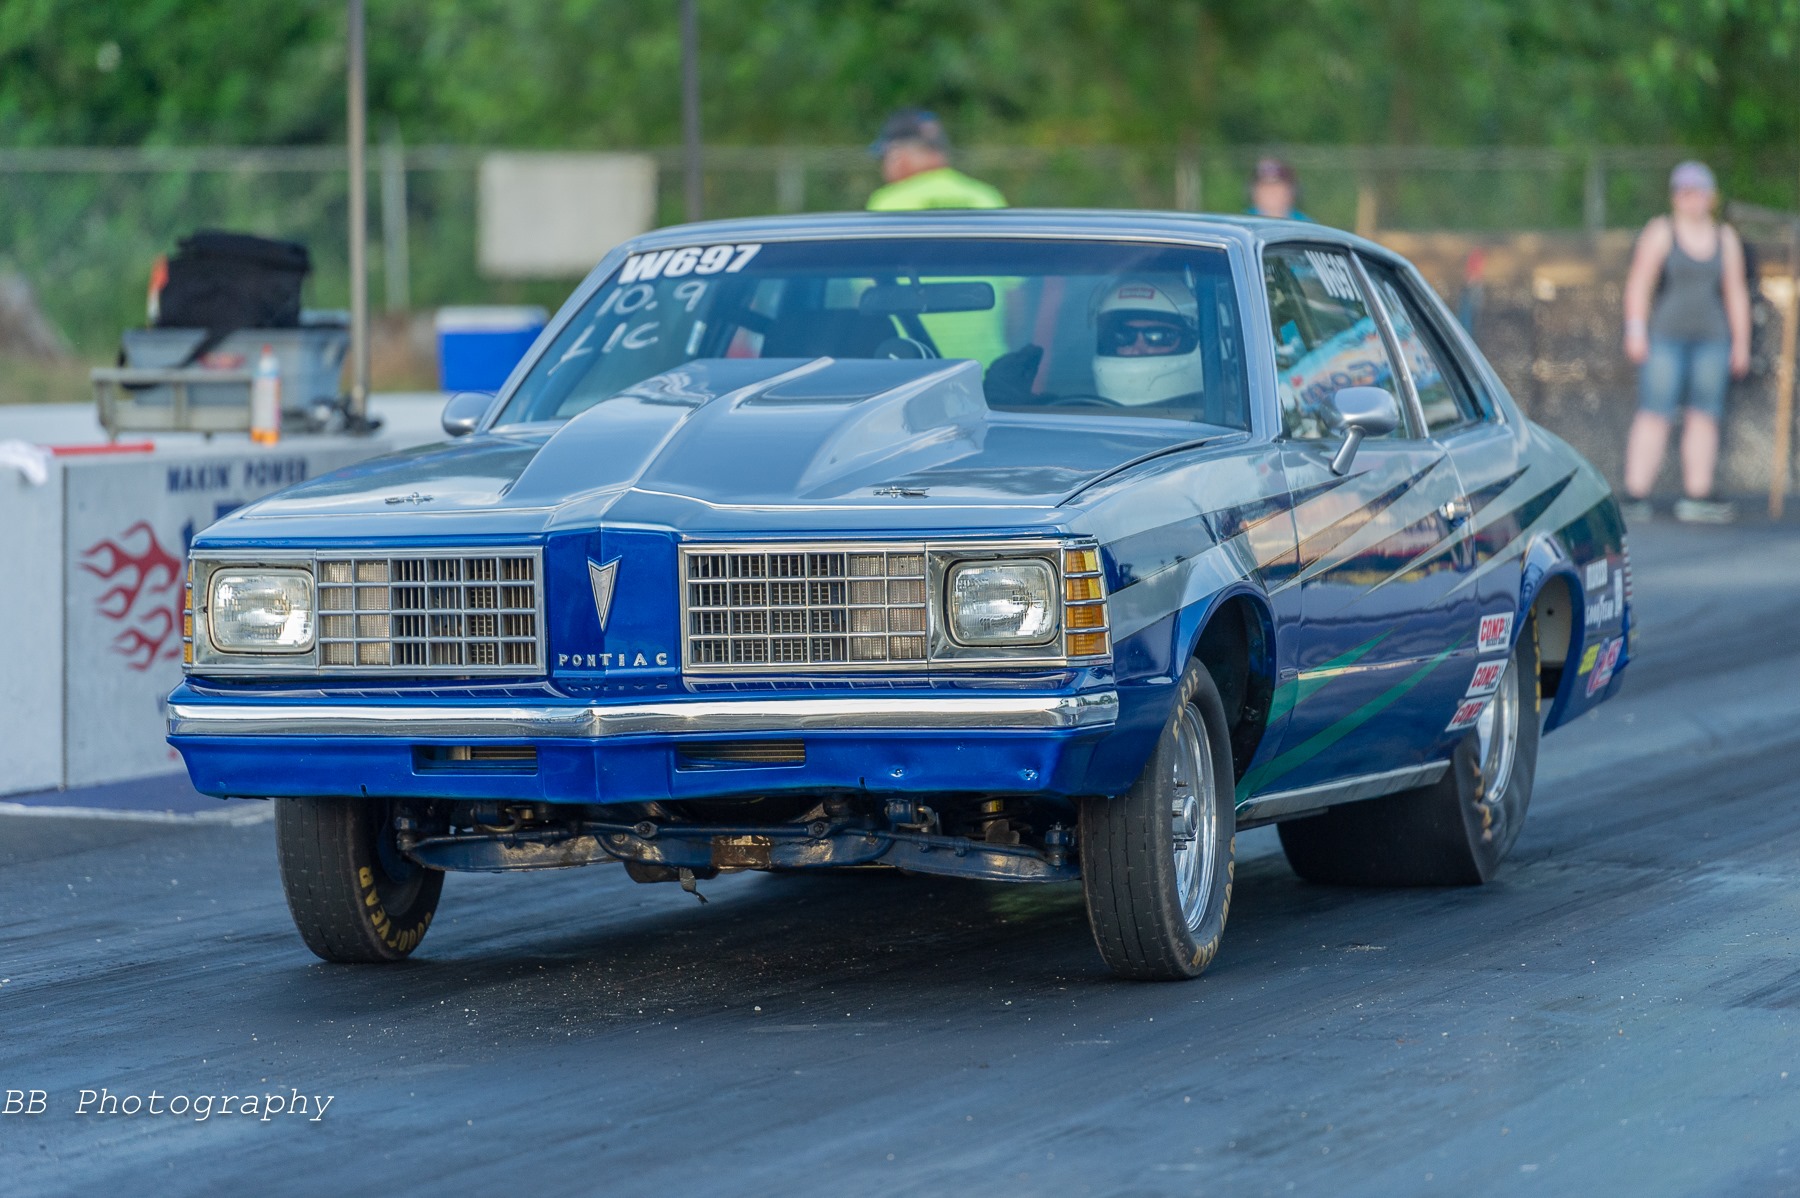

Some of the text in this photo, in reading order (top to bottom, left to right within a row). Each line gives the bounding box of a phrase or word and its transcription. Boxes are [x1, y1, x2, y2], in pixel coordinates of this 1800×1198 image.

[618, 243, 762, 285] W697
[245, 458, 308, 487] POWER
[1480, 617, 1506, 642] COMP
[558, 652, 668, 667] PONTIAC
[1471, 665, 1500, 689] COMP
[1452, 701, 1484, 724] COMP
